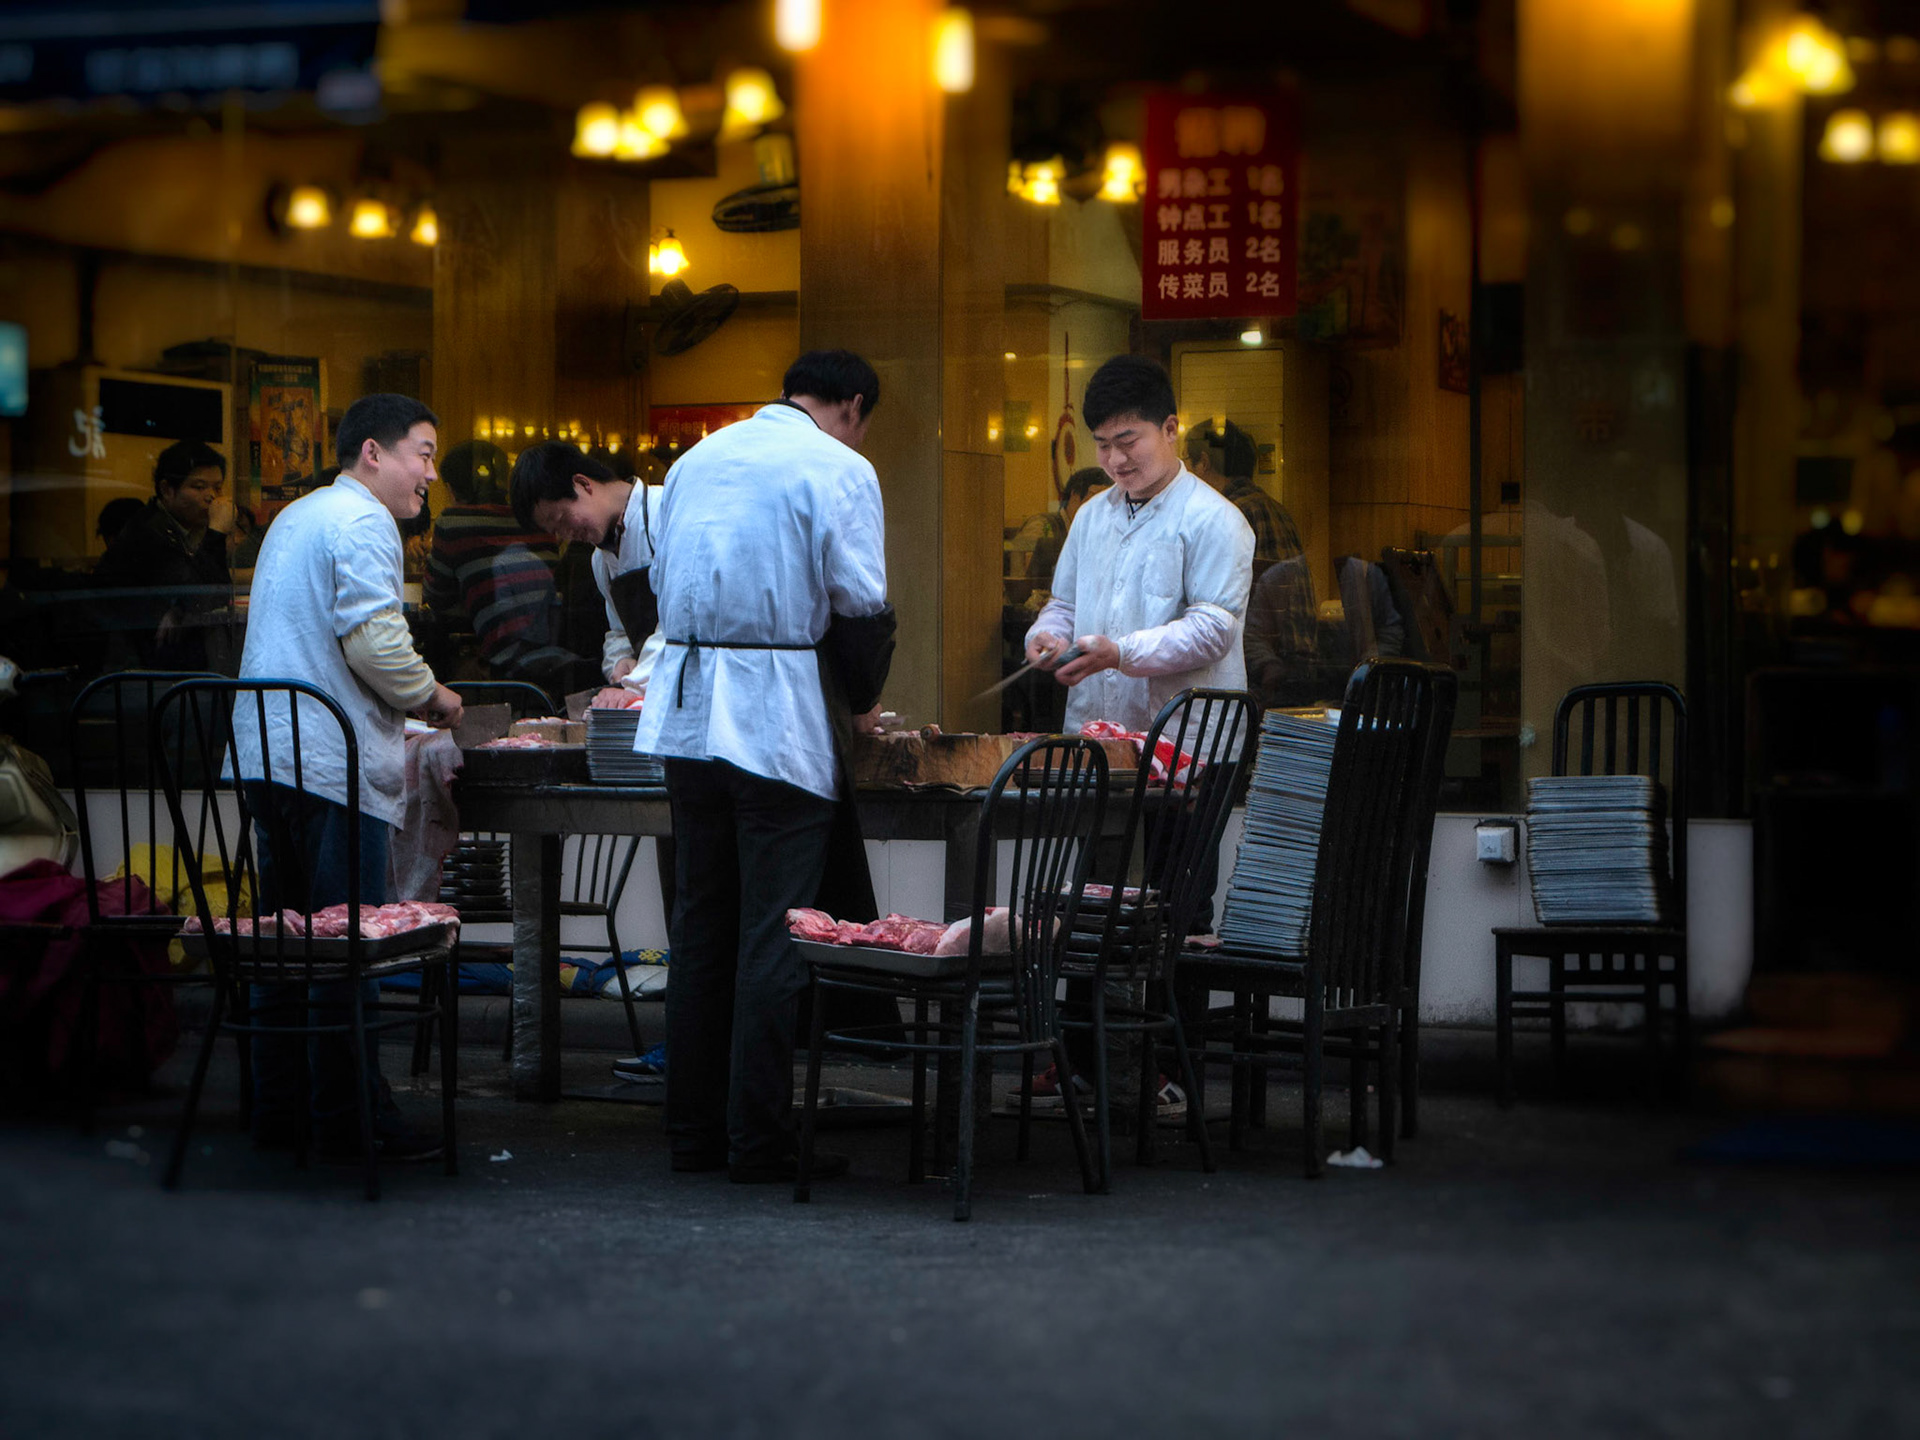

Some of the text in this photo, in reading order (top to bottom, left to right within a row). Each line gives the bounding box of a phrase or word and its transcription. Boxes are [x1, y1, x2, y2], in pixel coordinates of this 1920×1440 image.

[1157, 201, 1282, 232] 钟点工 1名
[1158, 235, 1280, 265] 服务员 2名
[1158, 271, 1280, 299] 传菜员 2名
